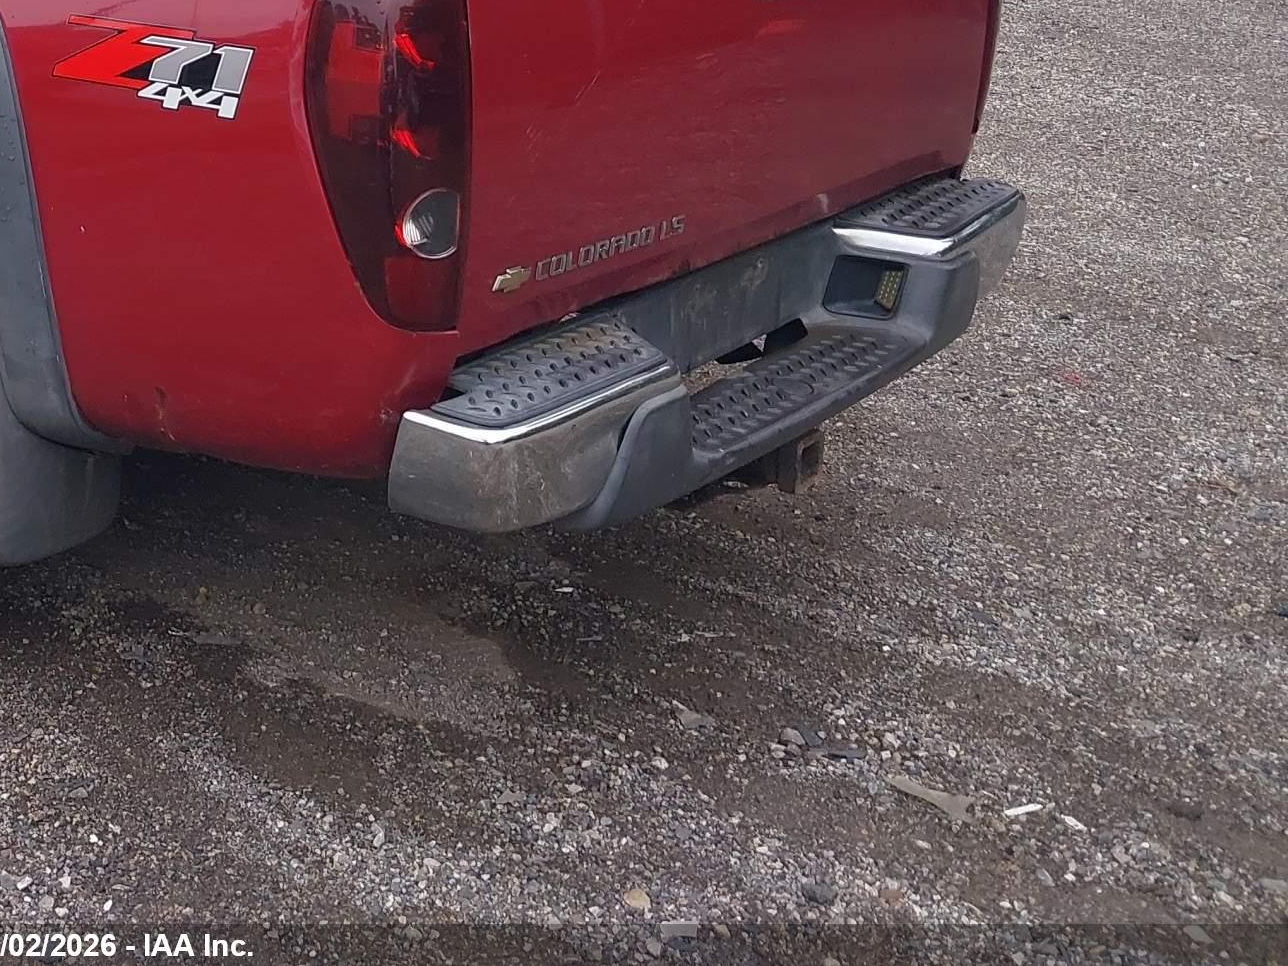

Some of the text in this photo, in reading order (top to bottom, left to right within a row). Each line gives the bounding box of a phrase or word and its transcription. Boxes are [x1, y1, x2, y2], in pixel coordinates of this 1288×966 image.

[52, 13, 256, 96] Z71
[535, 214, 687, 282] COLORADO LS
